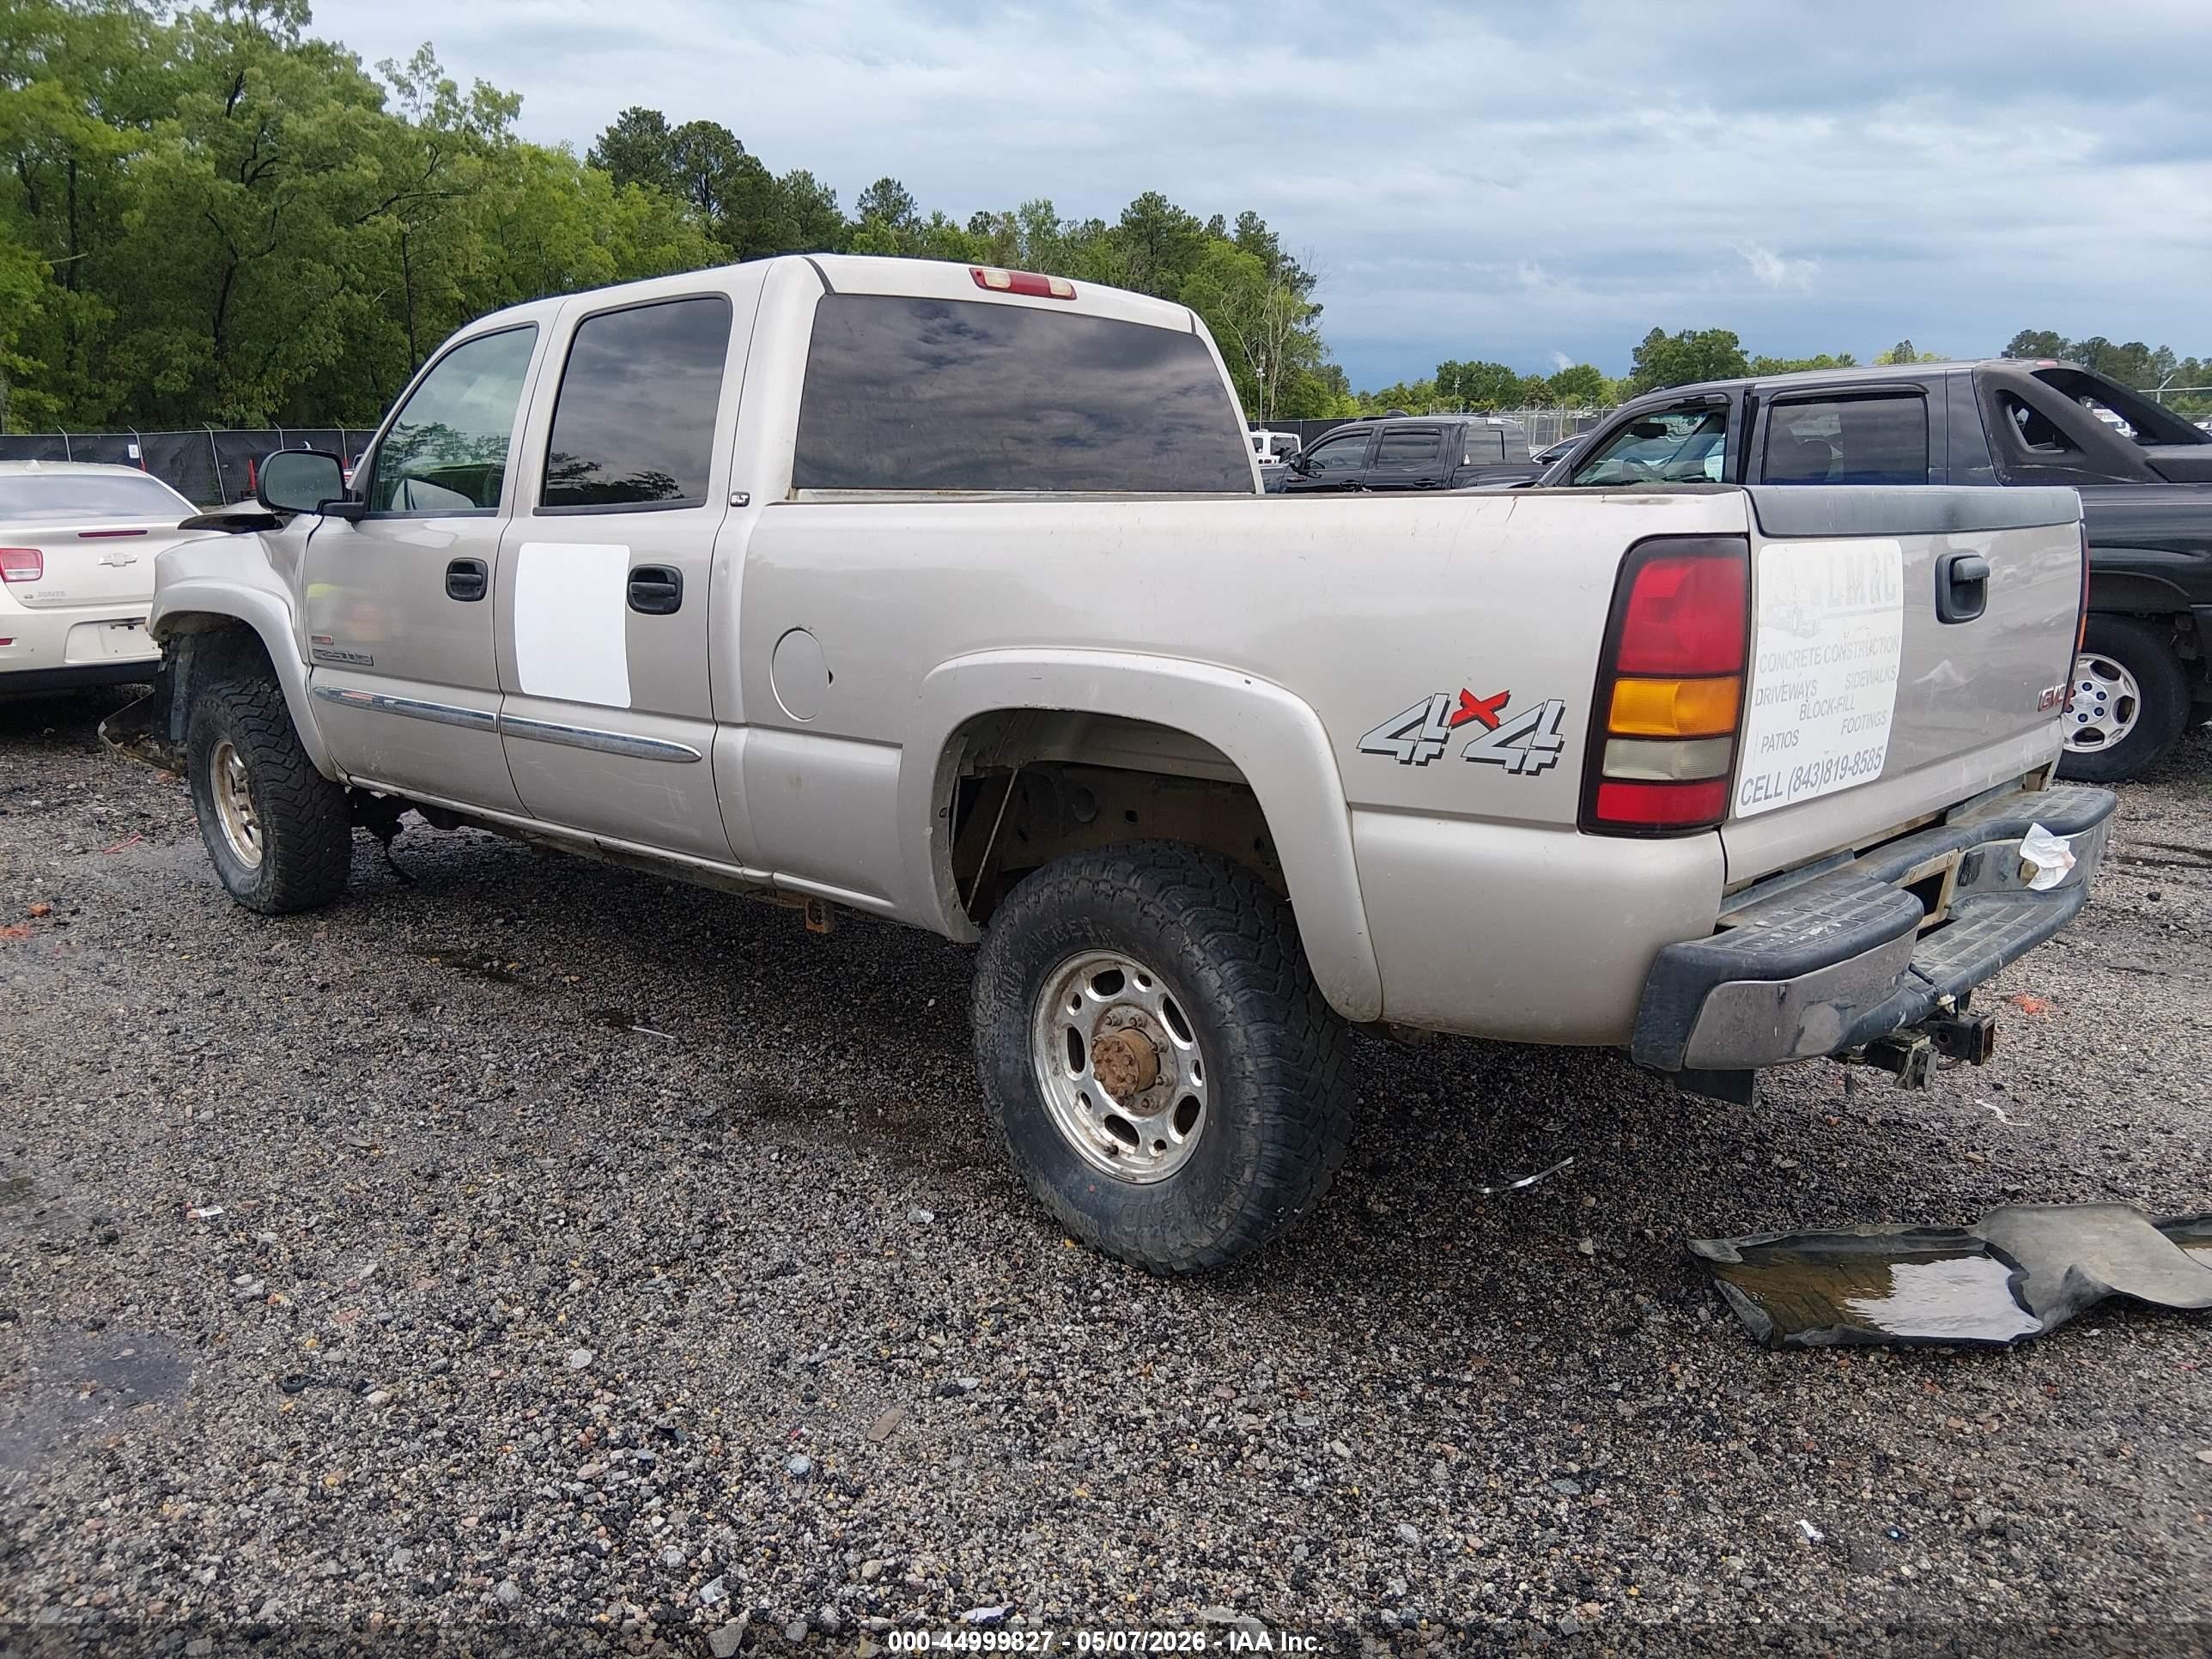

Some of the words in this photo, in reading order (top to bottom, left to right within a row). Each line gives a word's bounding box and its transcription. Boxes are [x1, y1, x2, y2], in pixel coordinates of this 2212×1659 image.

[1759, 647, 1821, 674] CONCRETE
[1824, 635, 1900, 664] CONSTRUCTION
[1755, 679, 1818, 707] DRIVEWAYS
[1845, 665, 1897, 690] SIDEWALKS
[1799, 694, 1856, 721] BLOCK-FILL
[1761, 729, 1800, 753] PATIOS
[1841, 710, 1887, 735] FOOTINGS
[1741, 771, 1783, 806] CELL
[1788, 745, 1884, 800] (843)819-8585
